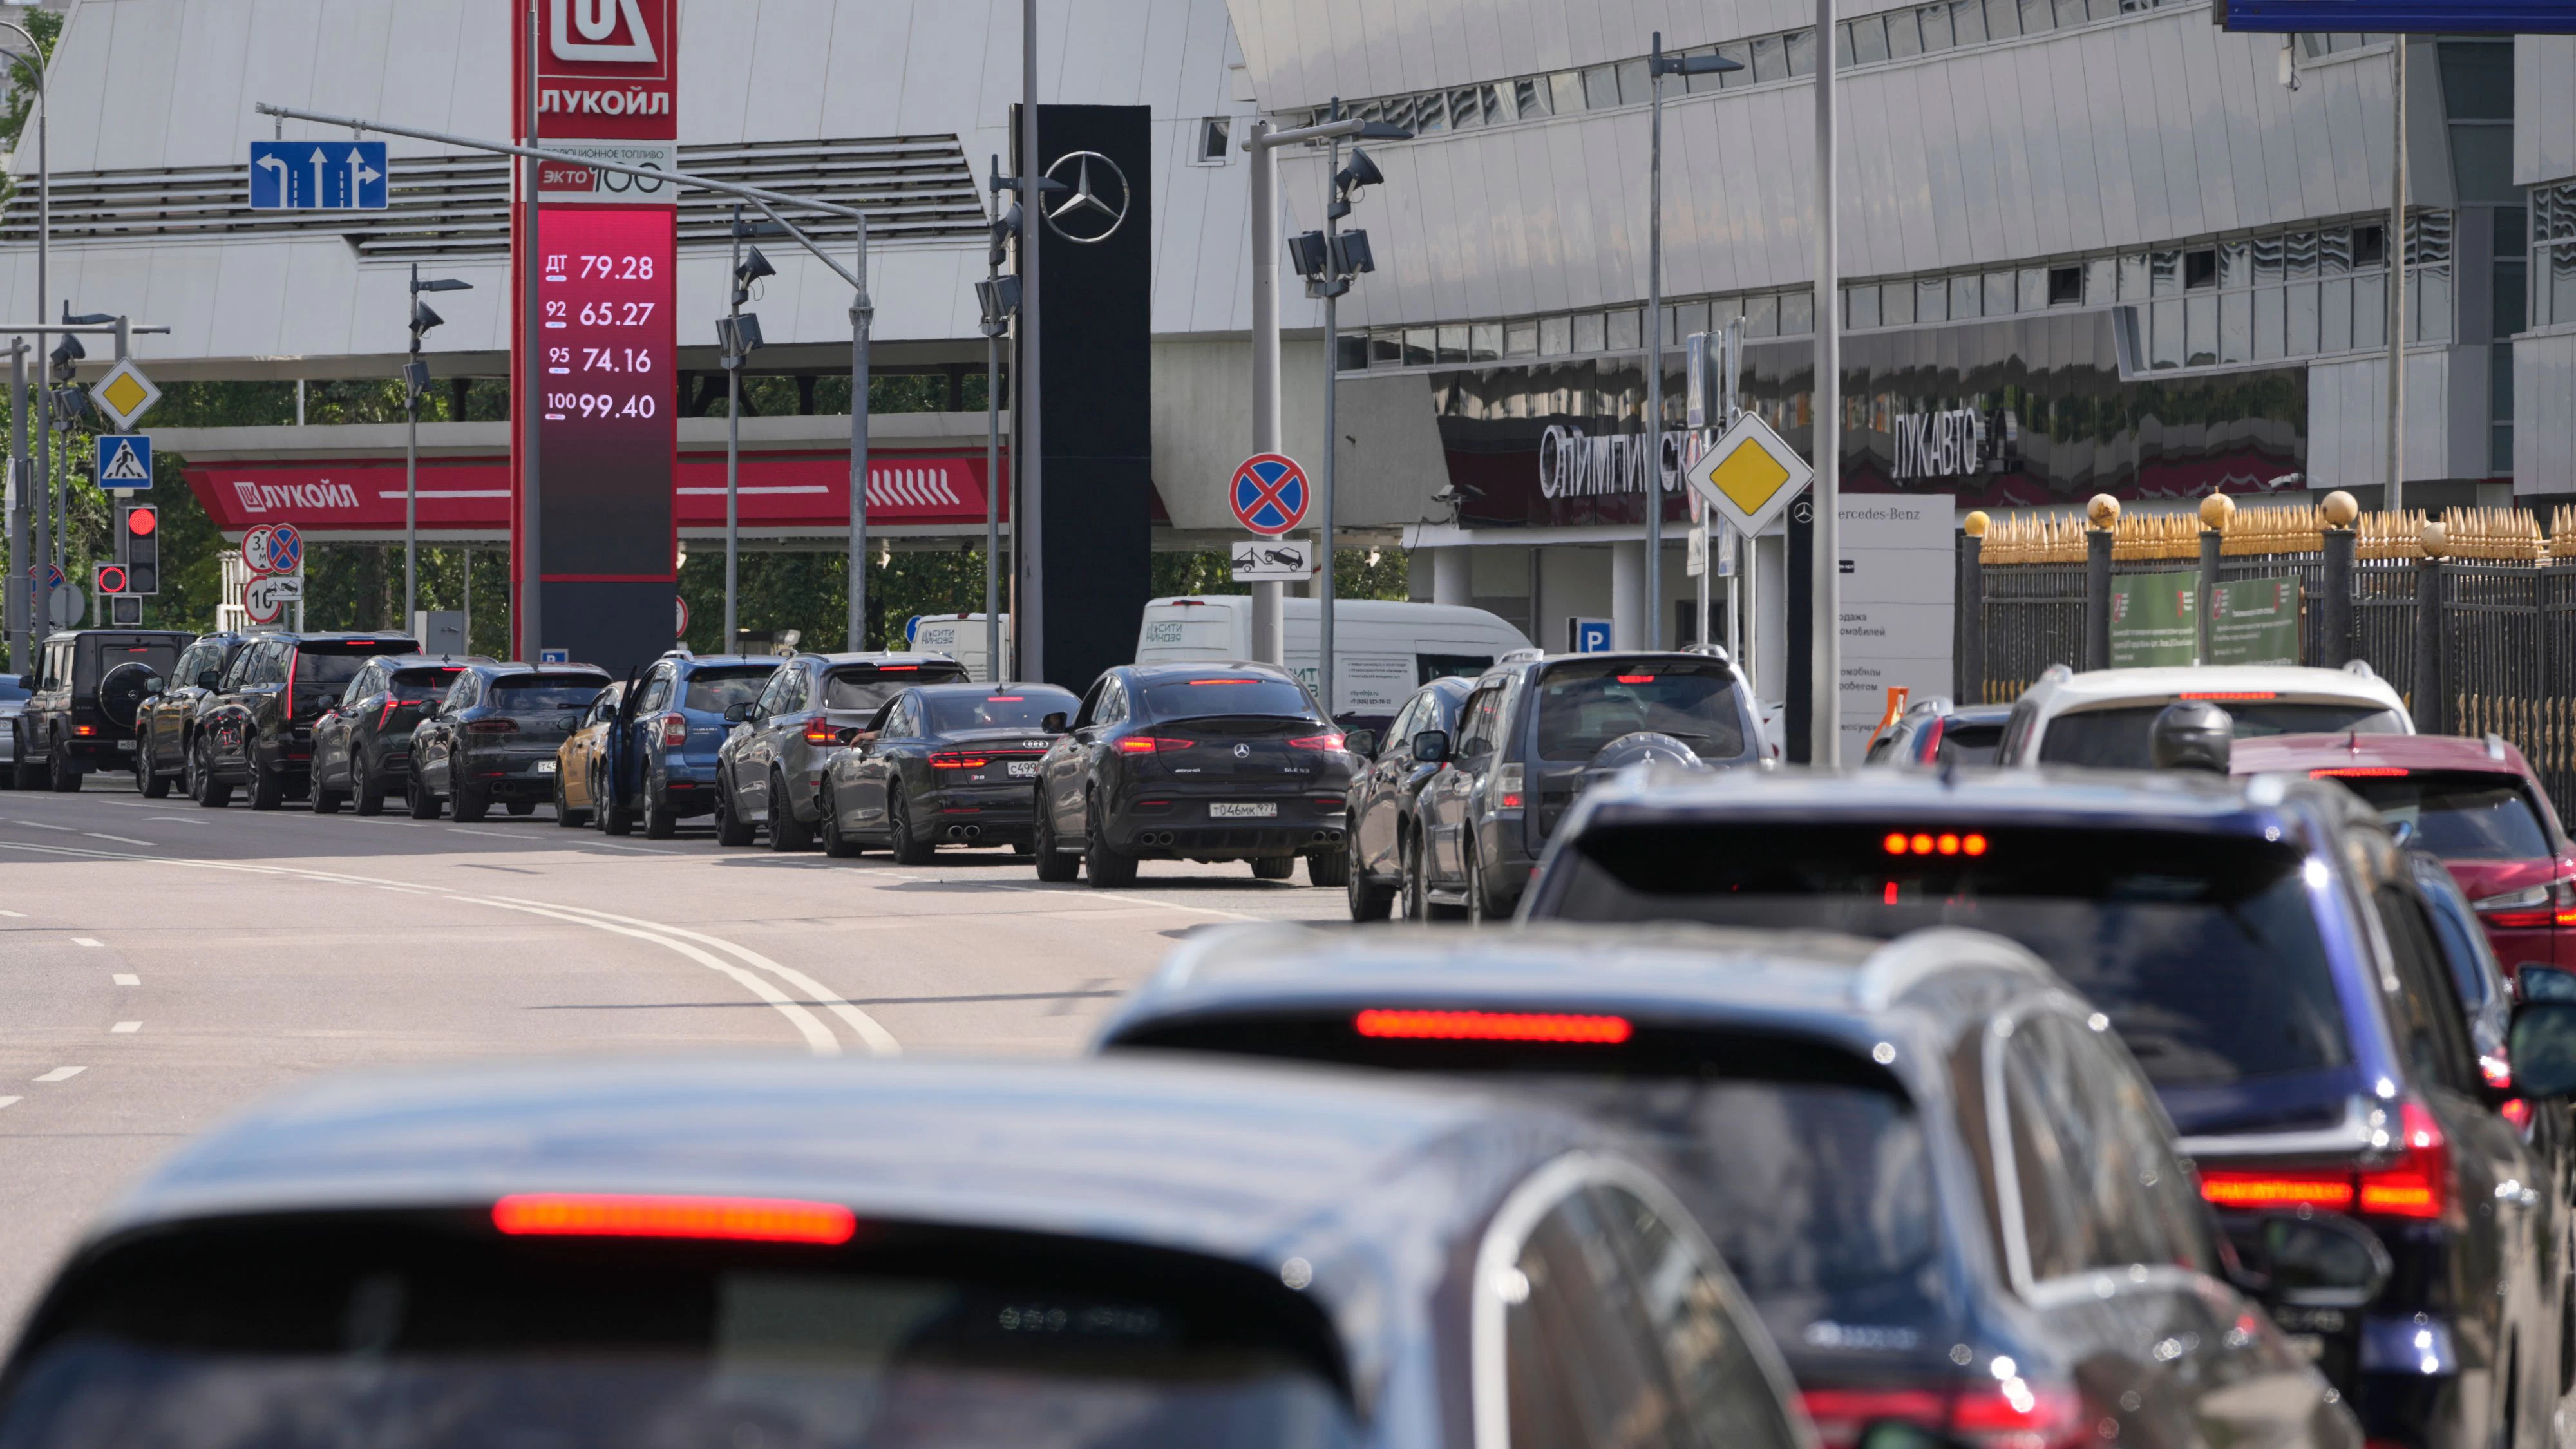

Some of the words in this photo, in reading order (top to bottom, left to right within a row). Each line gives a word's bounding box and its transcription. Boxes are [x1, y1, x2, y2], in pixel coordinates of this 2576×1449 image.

[538, 86, 670, 115] ЛУКОЙЛ
[621, 150, 664, 160] ТОПЛИВО
[542, 170, 588, 184] ЭКТО
[545, 254, 567, 272] ДТ
[580, 255, 653, 280] 79.28
[546, 301, 566, 316] 92
[580, 302, 655, 326] 65.27
[549, 347, 570, 363] 95
[583, 348, 652, 373] 74.16
[548, 393, 576, 409] 100
[579, 393, 655, 418] 99.40
[260, 478, 359, 508] ЛУКОЙЛ
[1838, 507, 1921, 520] ercedes-Benz
[1839, 614, 1866, 622] одажа
[1159, 623, 1182, 632] СИТИ
[1839, 626, 1886, 636] омобилей
[1587, 631, 1603, 652] P
[1840, 667, 1881, 677] омобили
[1213, 806, 1255, 815] Т046МК
[1258, 804, 1276, 813] 977
